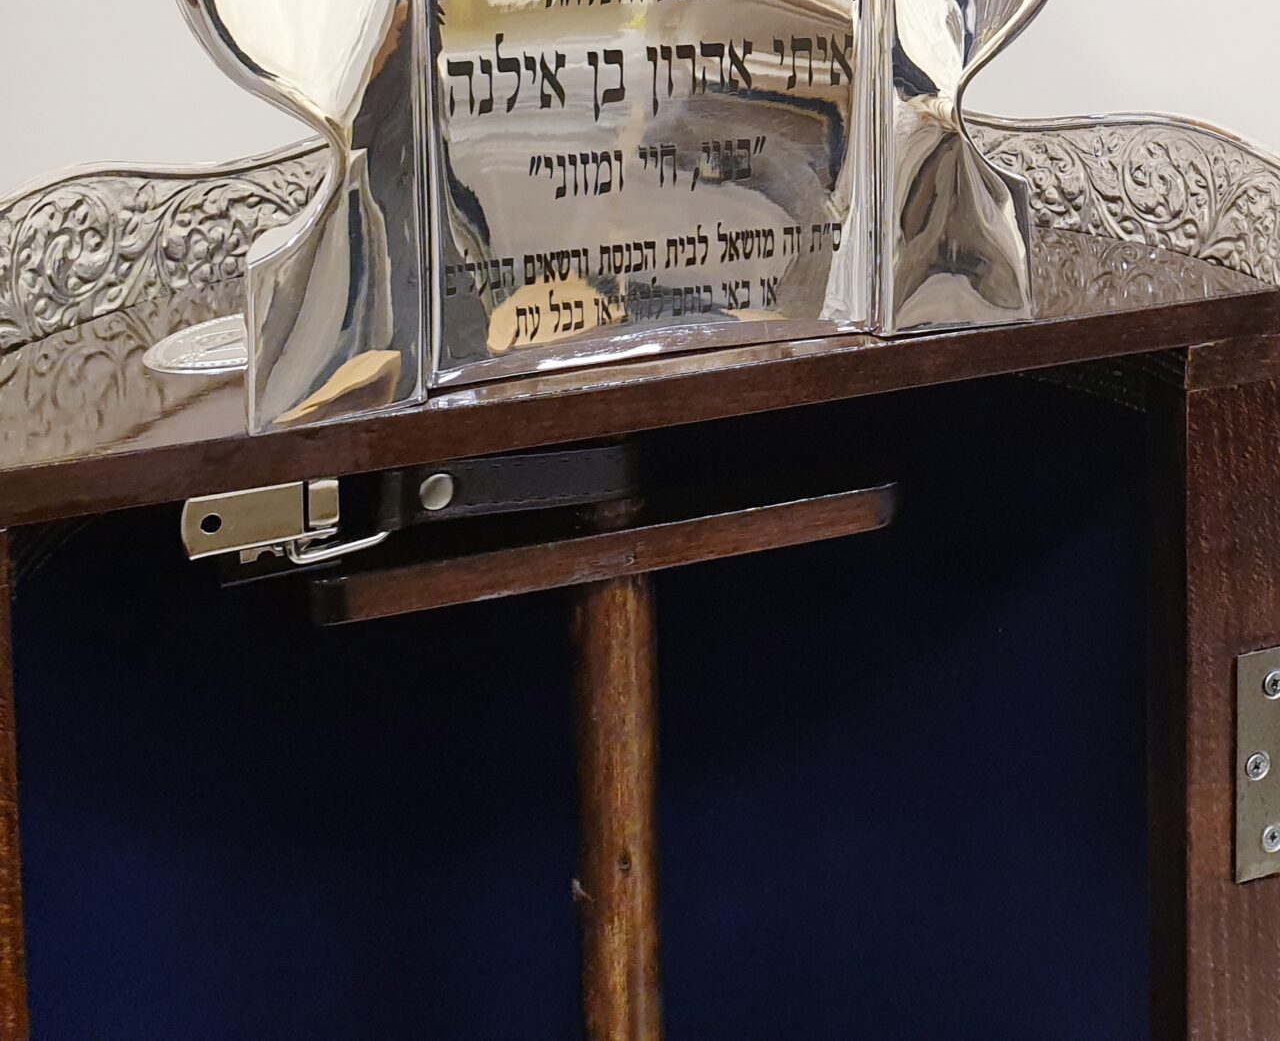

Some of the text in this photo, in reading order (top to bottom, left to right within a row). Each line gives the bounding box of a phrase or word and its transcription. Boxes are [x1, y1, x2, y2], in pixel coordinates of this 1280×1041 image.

[446, 33, 853, 122] איתי אהרון בן אילנה
[638, 143, 677, 188] חיי
[445, 222, 842, 296] ס"ת זה מושאל לבית הכנסת ורשאים הבעלים
[549, 290, 584, 332] בכל
[722, 280, 750, 310] באי
[760, 276, 778, 307] או
[515, 304, 540, 341] עת
